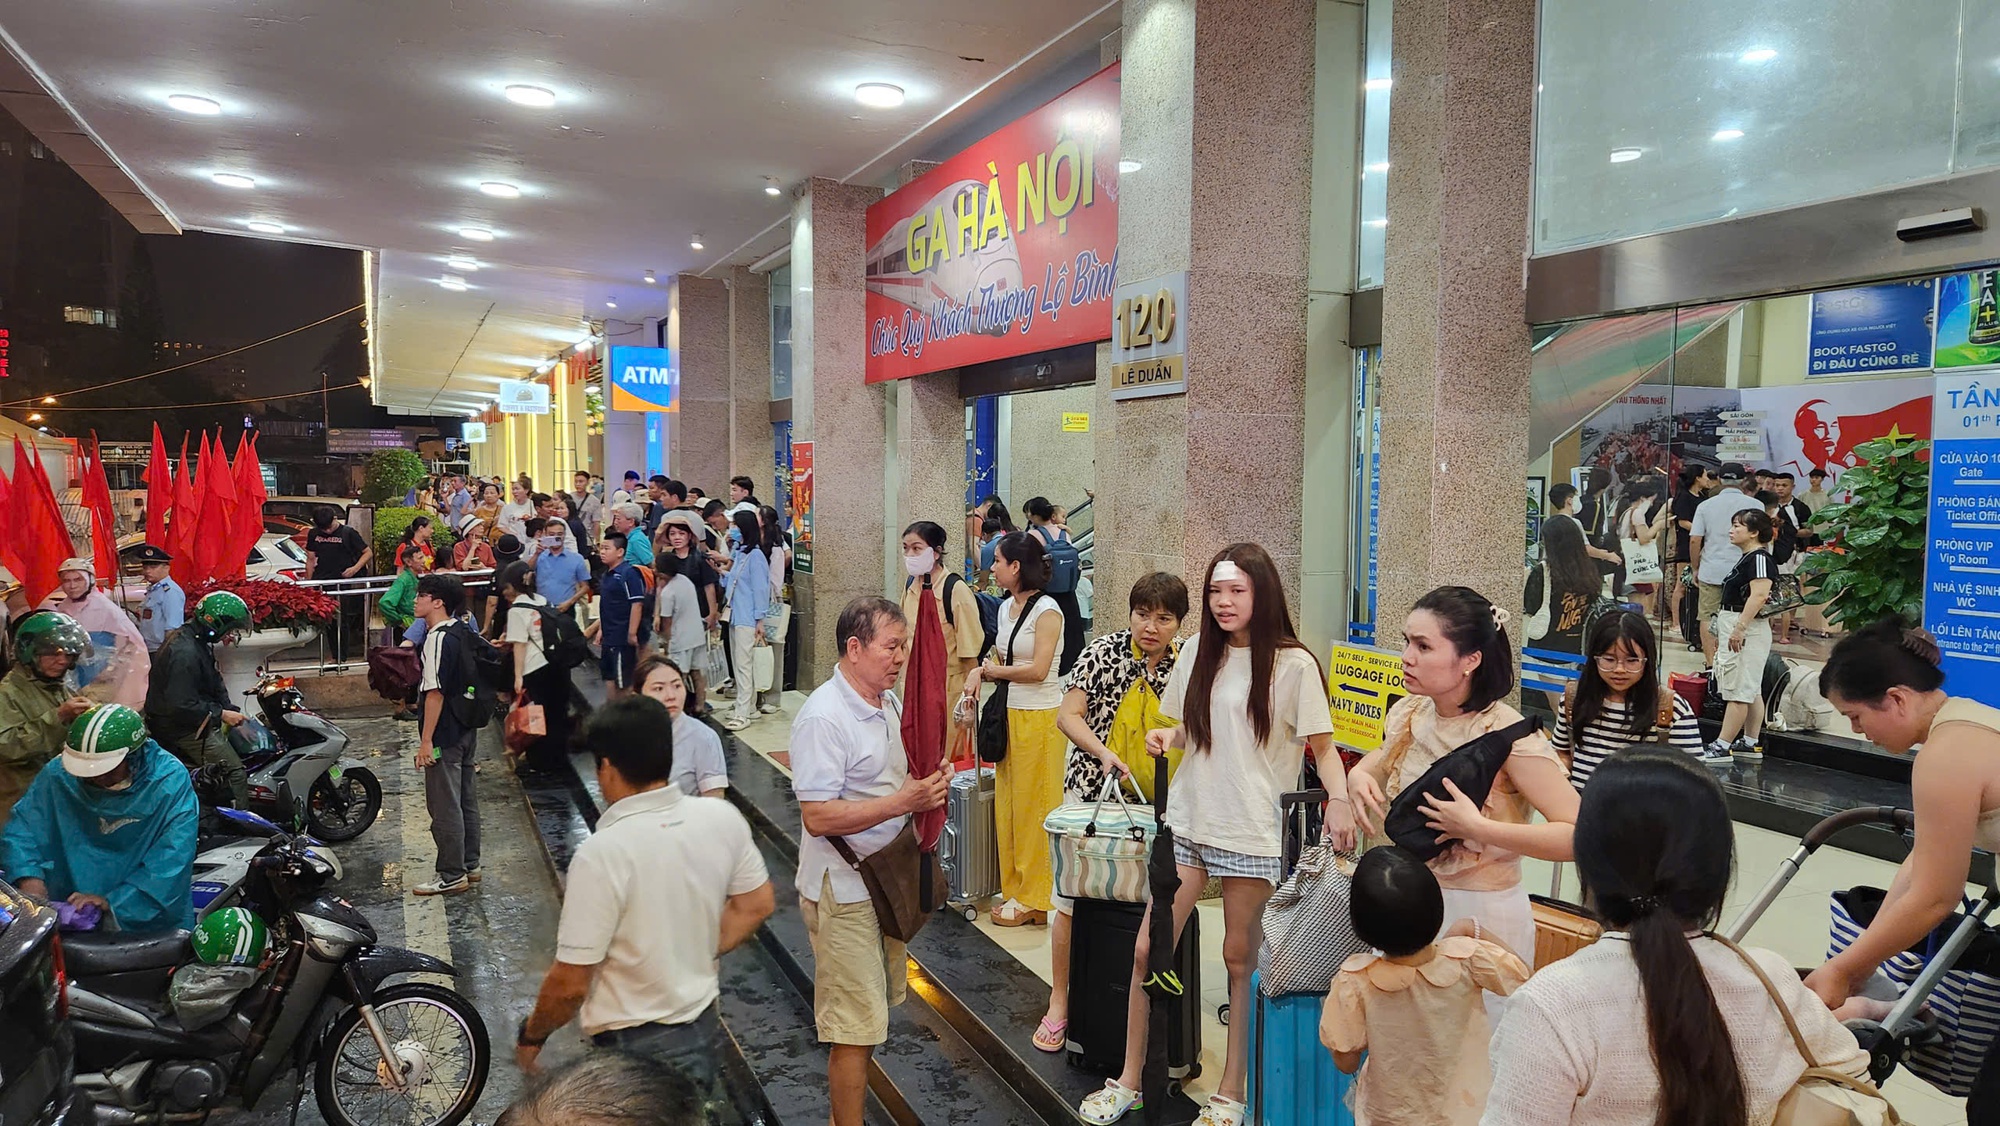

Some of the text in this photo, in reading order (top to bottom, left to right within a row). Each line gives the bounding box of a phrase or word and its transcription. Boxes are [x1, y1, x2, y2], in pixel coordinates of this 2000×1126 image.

[906, 126, 1096, 275] GA HÀ NỘI
[870, 314, 899, 358] Chúc
[900, 307, 926, 359] Quý
[927, 290, 973, 343] Khách
[976, 283, 1039, 335] Thượng
[1040, 261, 1069, 322] Lộ
[1117, 287, 1176, 350] 120
[1814, 342, 1896, 357] BOOK FASTGO
[1813, 360, 1826, 370] ĐI
[1829, 357, 1856, 369] ĐÂU
[1859, 355, 1898, 367] CŨNG
[622, 365, 669, 386] ATM
[1121, 360, 1172, 385] LÊ DUẨN
[1940, 451, 1962, 464] CỬA
[1965, 451, 1988, 464] VÀO
[1960, 467, 1983, 477] Gate
[1937, 495, 1976, 507] PHÒNG
[1946, 510, 1976, 521] Ticket
[1935, 538, 1993, 551] PHÒNG VIP
[1940, 552, 1988, 565] Vip Room
[1933, 580, 2000, 596] NHÀ VỆ SINH
[1956, 597, 1976, 608] WC
[1931, 622, 1948, 635] LỐI
[1951, 625, 1972, 638] LÊN
[1936, 640, 1961, 650] ntrance
[1963, 641, 1970, 651] to
[1971, 642, 1982, 652] the
[1337, 651, 1351, 659] 24/7
[1368, 657, 1393, 668] SERVICE
[1335, 663, 1383, 684] LUGGAGE
[1330, 695, 1354, 713] NAVY
[1354, 701, 1382, 720] BOXES
